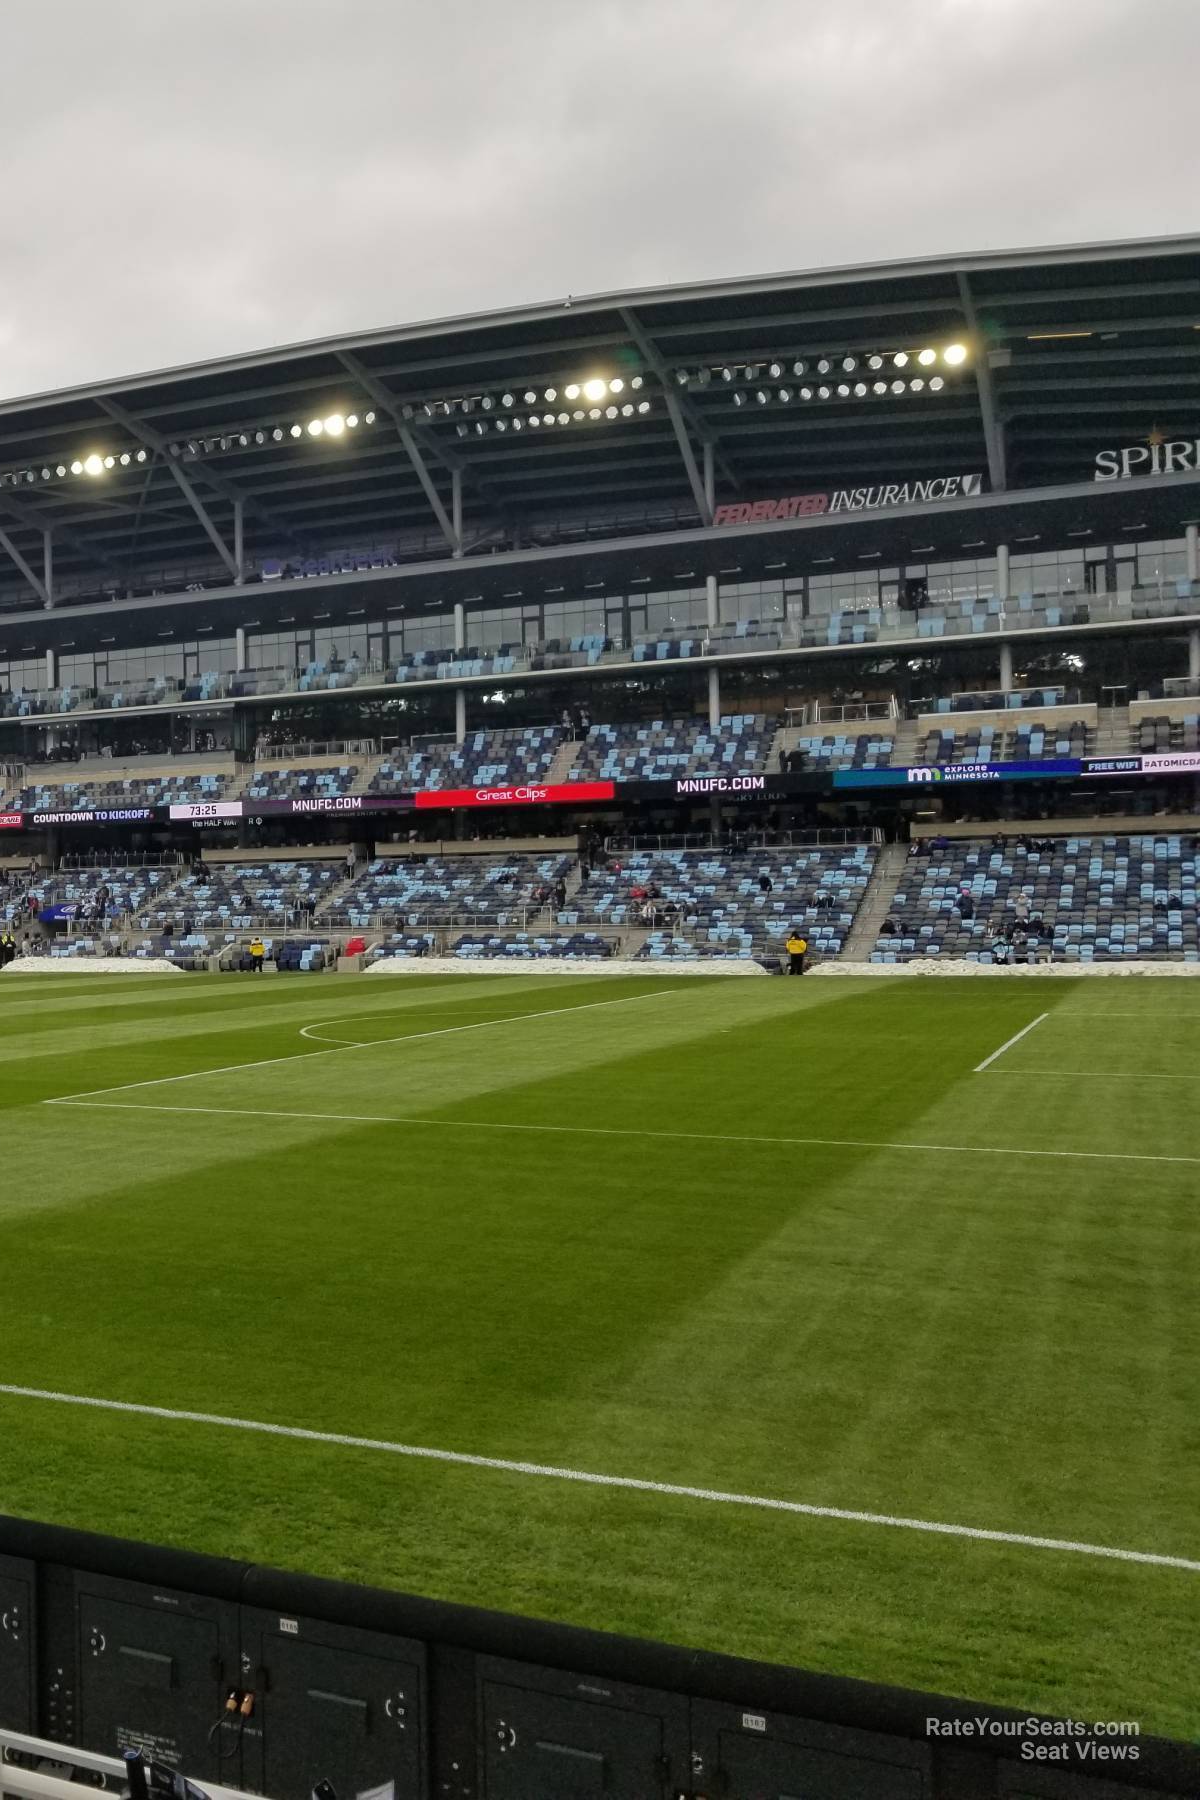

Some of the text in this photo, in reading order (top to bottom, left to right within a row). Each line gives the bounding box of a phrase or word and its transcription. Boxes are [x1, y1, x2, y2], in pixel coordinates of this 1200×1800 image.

[713, 476, 961, 525] FEDERATED INSURANCE
[1088, 760, 1138, 771] FREE WIFI
[676, 776, 765, 793] MNUFC.COM
[475, 787, 546, 801] Great Clips
[189, 805, 217, 816] 73:25
[292, 797, 362, 812] MNUFC.COM
[33, 812, 93, 824] COUNTDOWN
[94, 811, 108, 822] TO
[203, 818, 222, 827] HALF
